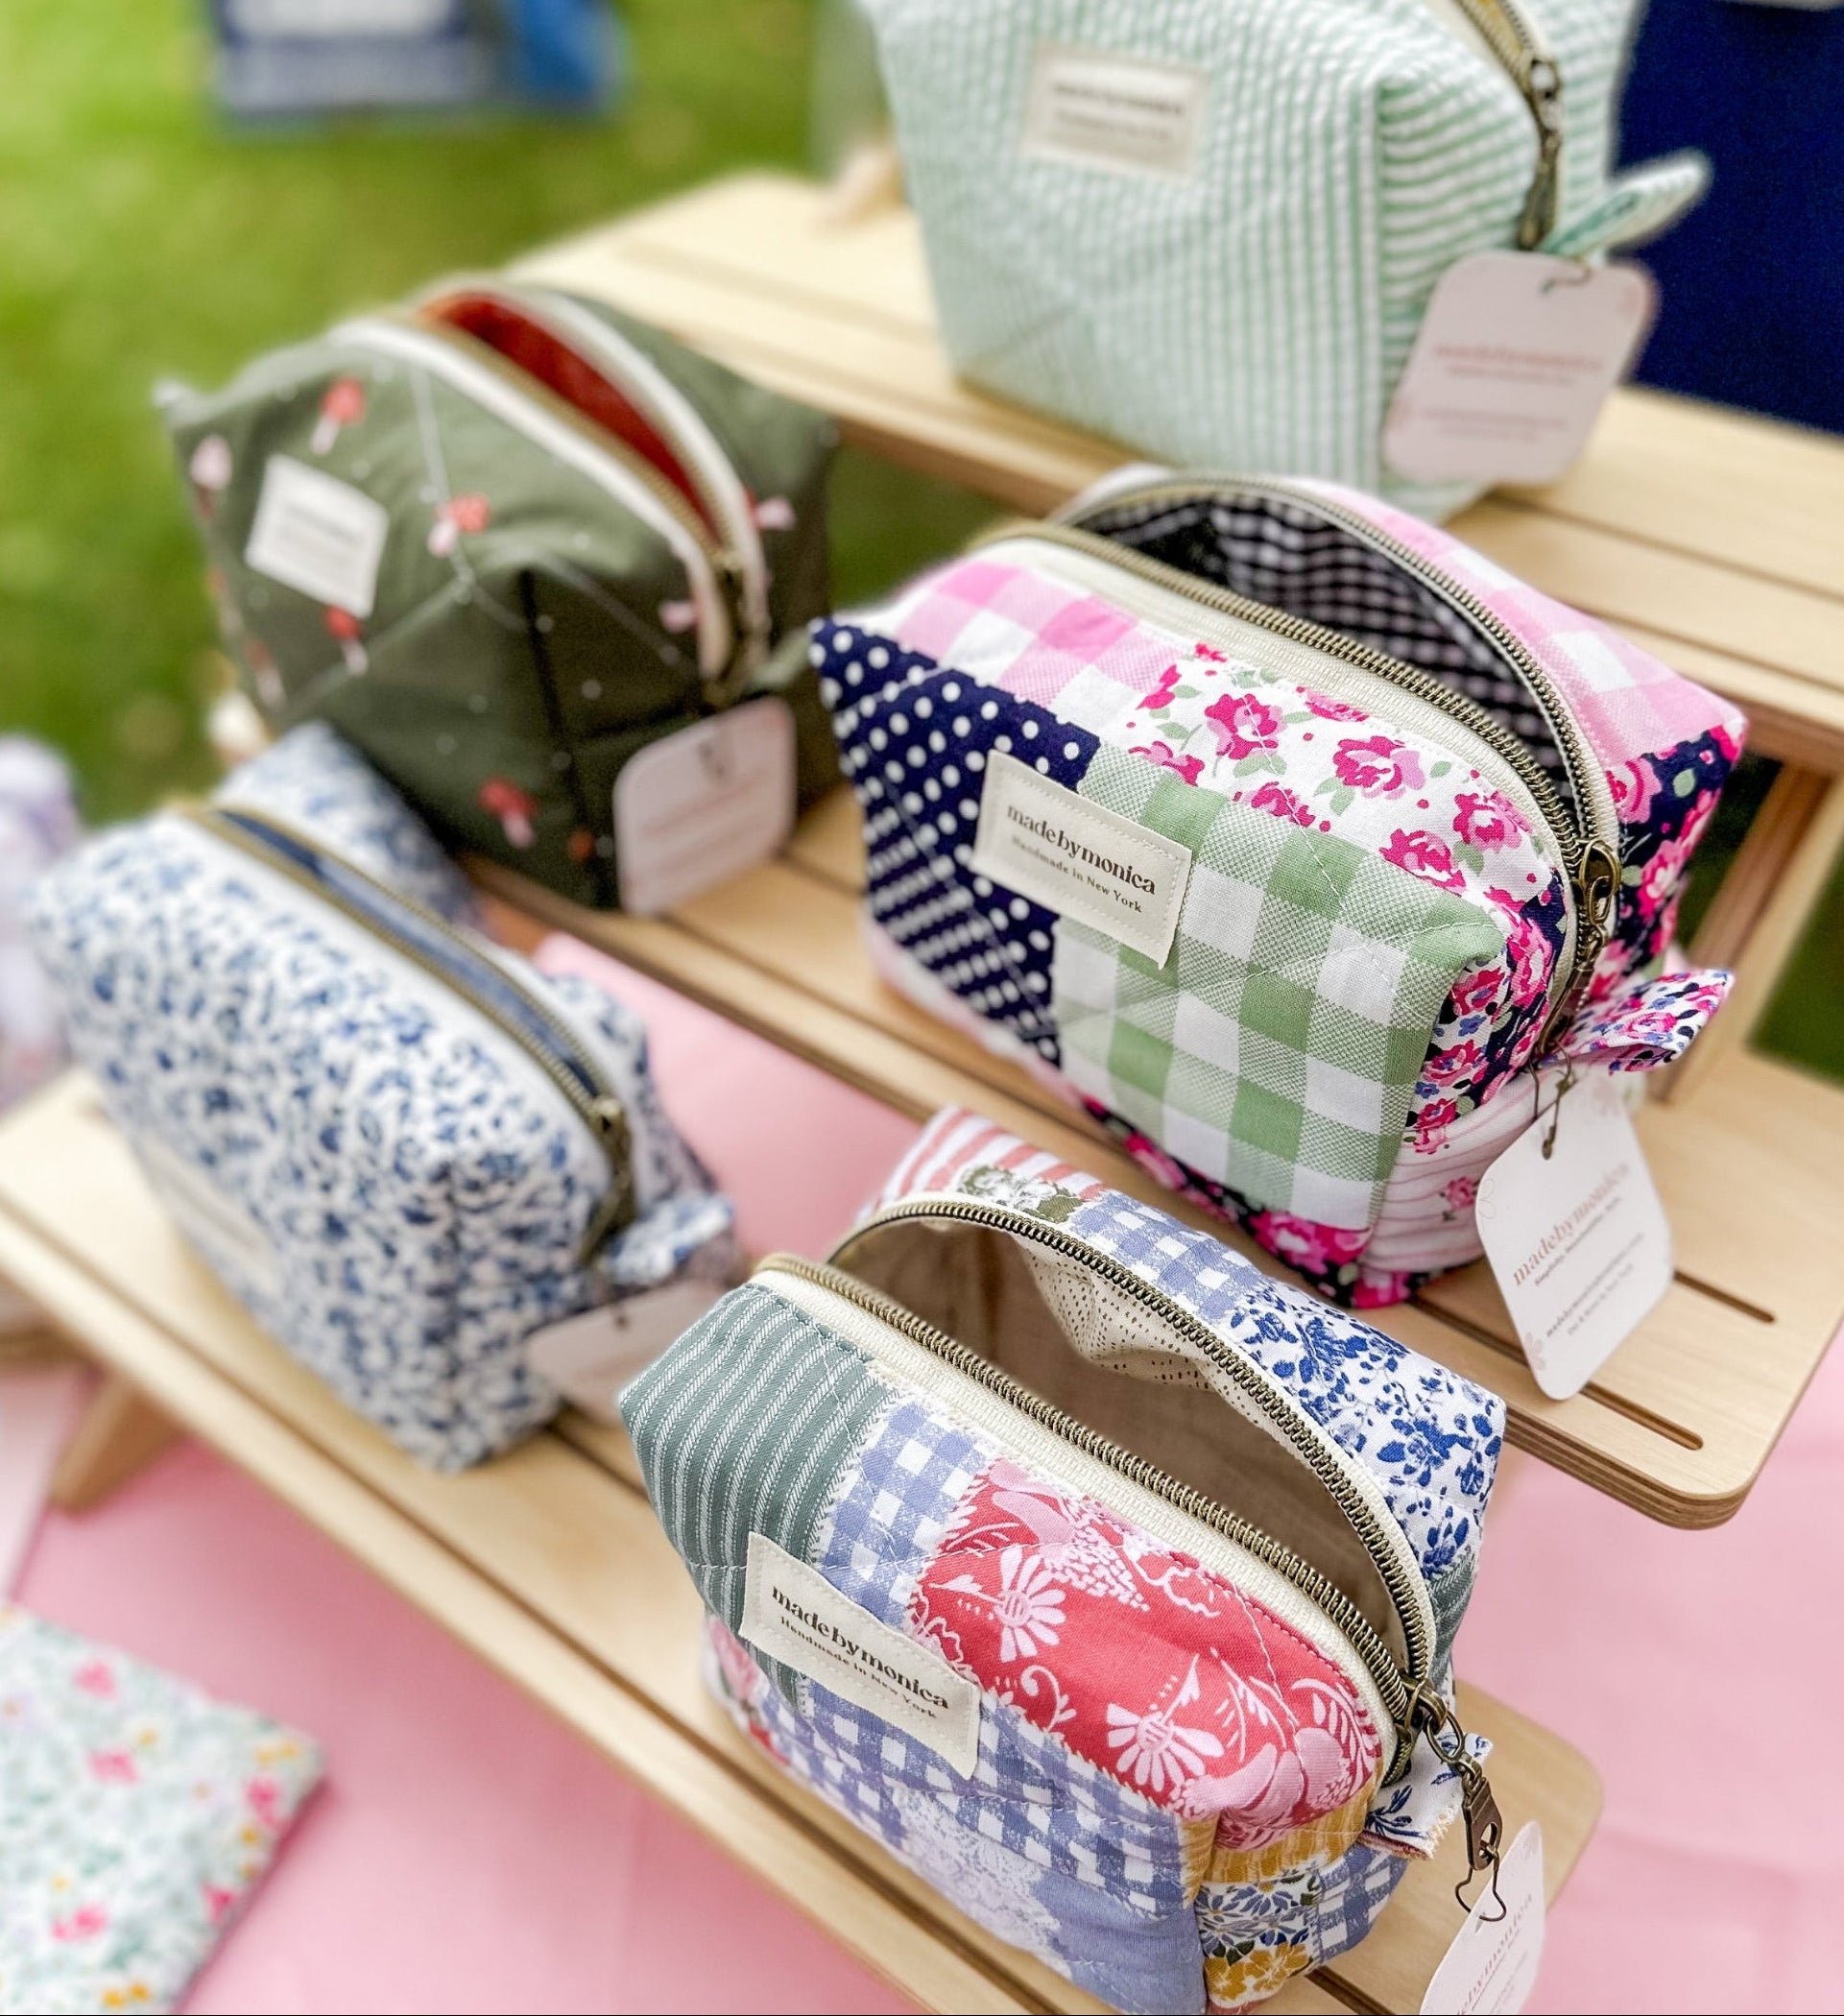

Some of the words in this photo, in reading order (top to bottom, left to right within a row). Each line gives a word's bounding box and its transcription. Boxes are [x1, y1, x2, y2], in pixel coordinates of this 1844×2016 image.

[1006, 804, 1156, 896] madebymonica
[1012, 835, 1069, 875] Handmade
[1071, 867, 1084, 882] in
[1087, 875, 1111, 896] New
[1113, 889, 1142, 914] York
[772, 1585, 949, 1710] madebymonica
[780, 1616, 850, 1666] Handmade
[852, 1662, 867, 1676] in
[871, 1673, 898, 1695] New
[902, 1693, 937, 1718] York
